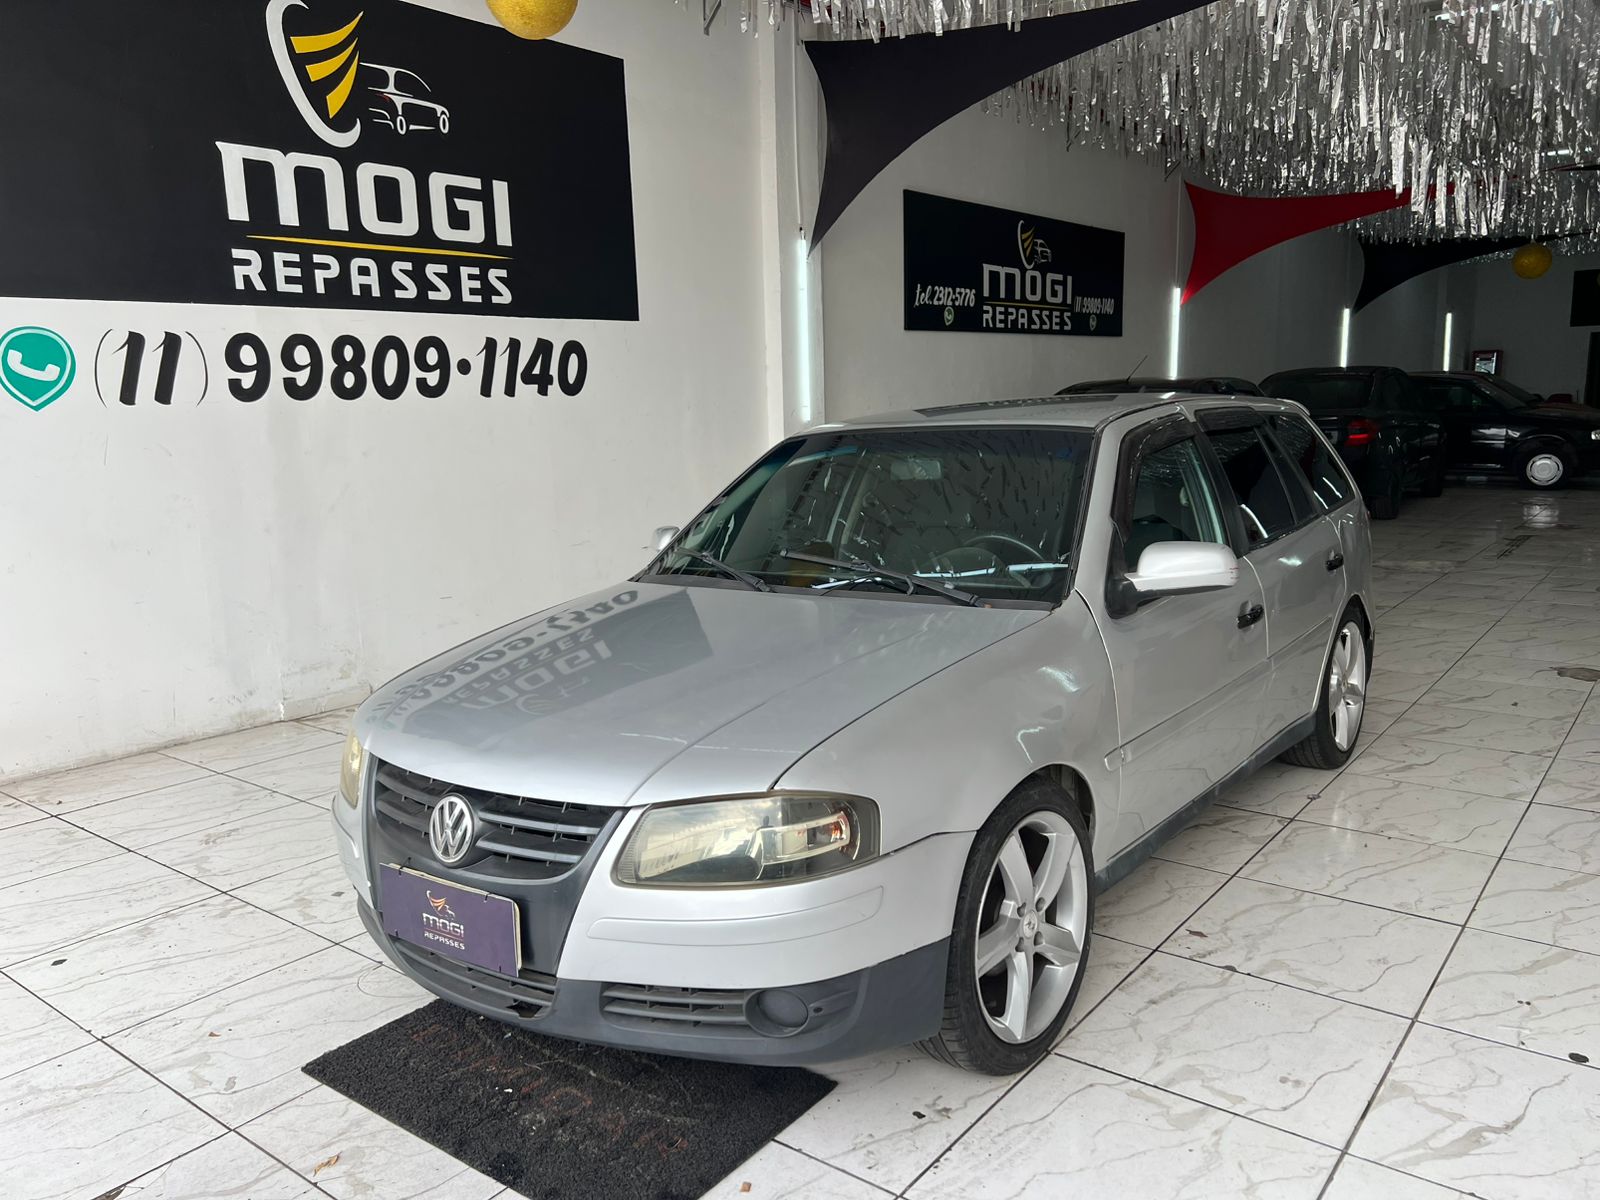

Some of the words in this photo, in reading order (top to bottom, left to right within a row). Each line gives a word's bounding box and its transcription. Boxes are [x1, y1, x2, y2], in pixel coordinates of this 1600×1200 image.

[215, 140, 513, 247] MOGI
[231, 247, 513, 305] REPASSES
[982, 263, 1073, 305] MOGI
[982, 305, 1073, 331] REPASSES
[95, 328, 209, 408] (11)
[422, 912, 465, 938] MOGI
[424, 932, 466, 950] REPASSES
